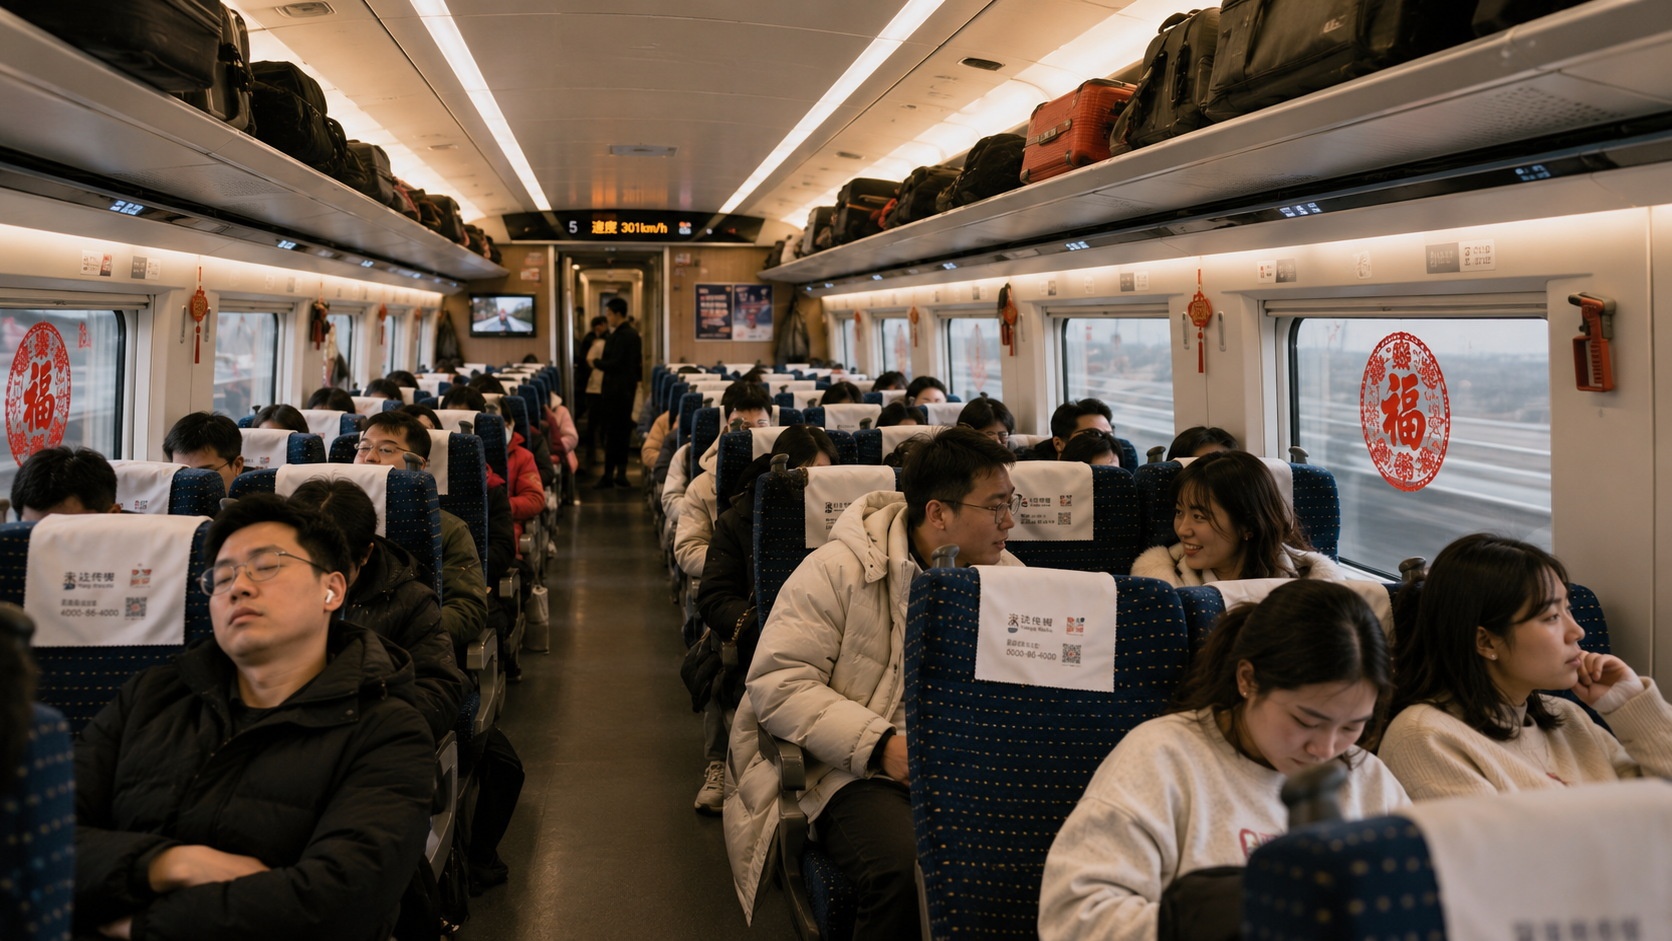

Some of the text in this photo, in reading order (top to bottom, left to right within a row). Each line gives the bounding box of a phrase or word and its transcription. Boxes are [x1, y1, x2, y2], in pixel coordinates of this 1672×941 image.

[569, 220, 578, 234] 5
[621, 222, 668, 234] 301km/h
[24, 360, 55, 432] 福
[1381, 373, 1426, 451] 福
